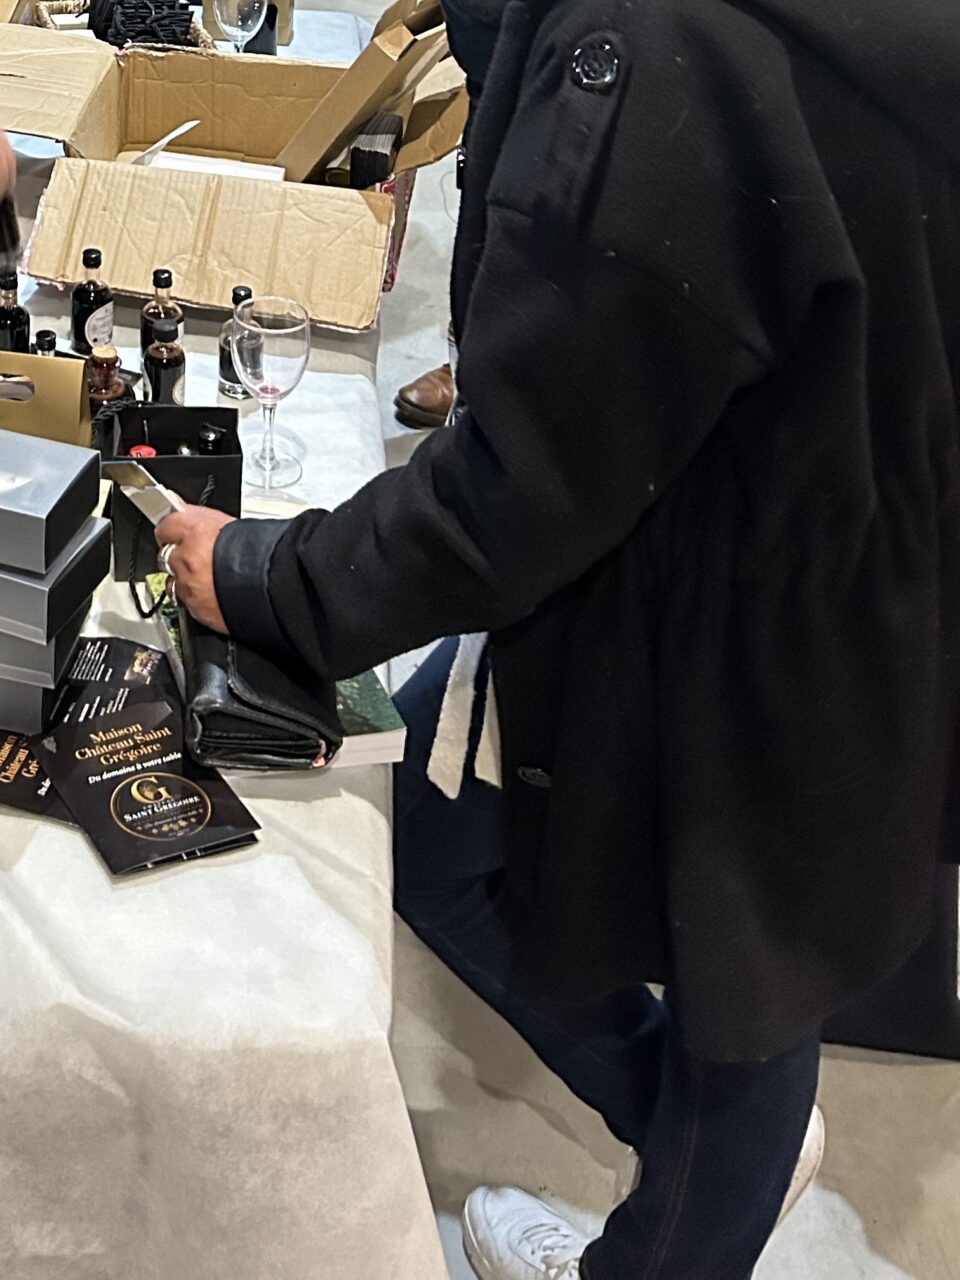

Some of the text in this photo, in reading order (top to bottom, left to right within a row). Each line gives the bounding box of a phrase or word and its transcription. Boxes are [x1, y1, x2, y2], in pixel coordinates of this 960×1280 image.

[75, 726, 172, 760] Château Saint
[89, 723, 143, 744] Maison
[88, 775, 101, 784] Du
[102, 764, 136, 780] domaine
[142, 757, 162, 768] votre
[162, 751, 182, 762] table
[100, 742, 162, 765] Grégoire
